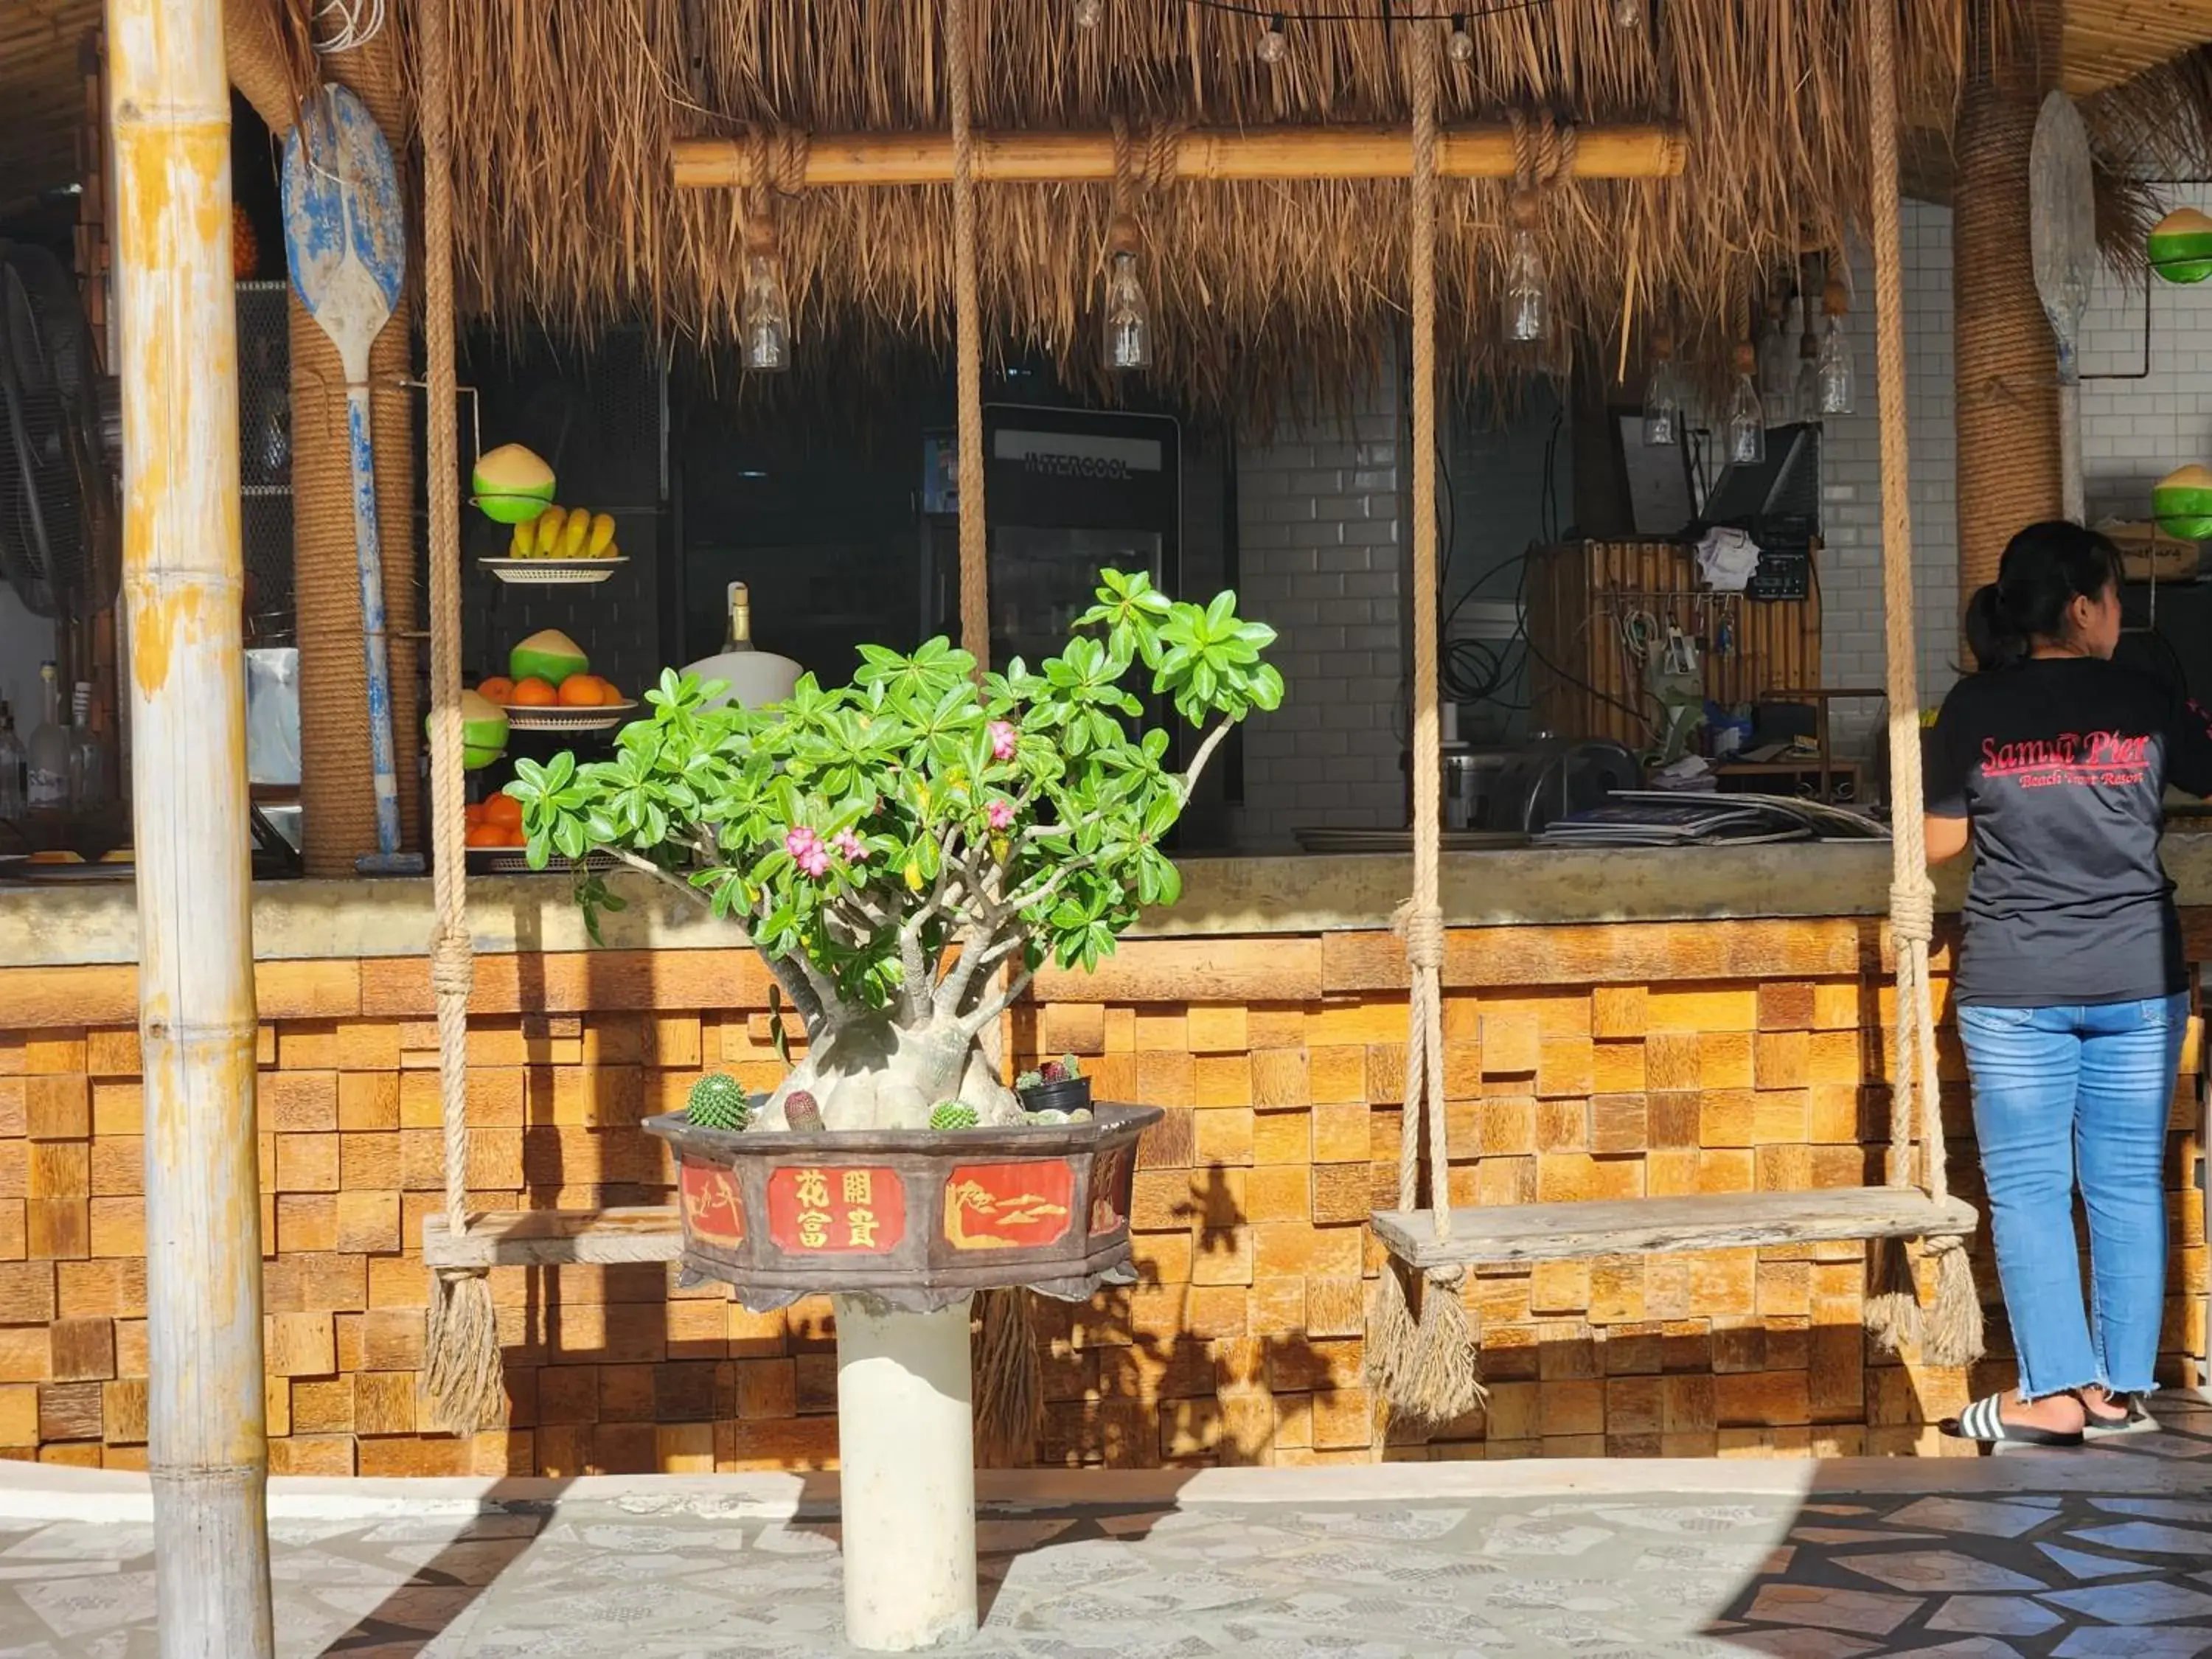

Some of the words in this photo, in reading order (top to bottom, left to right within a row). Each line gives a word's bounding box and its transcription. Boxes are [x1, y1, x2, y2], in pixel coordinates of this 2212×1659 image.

[1024, 451, 1133, 479] INTERCOOL
[1981, 733, 2077, 769] Samui
[2084, 730, 2149, 764] Pier
[2020, 769, 2062, 787] Beach
